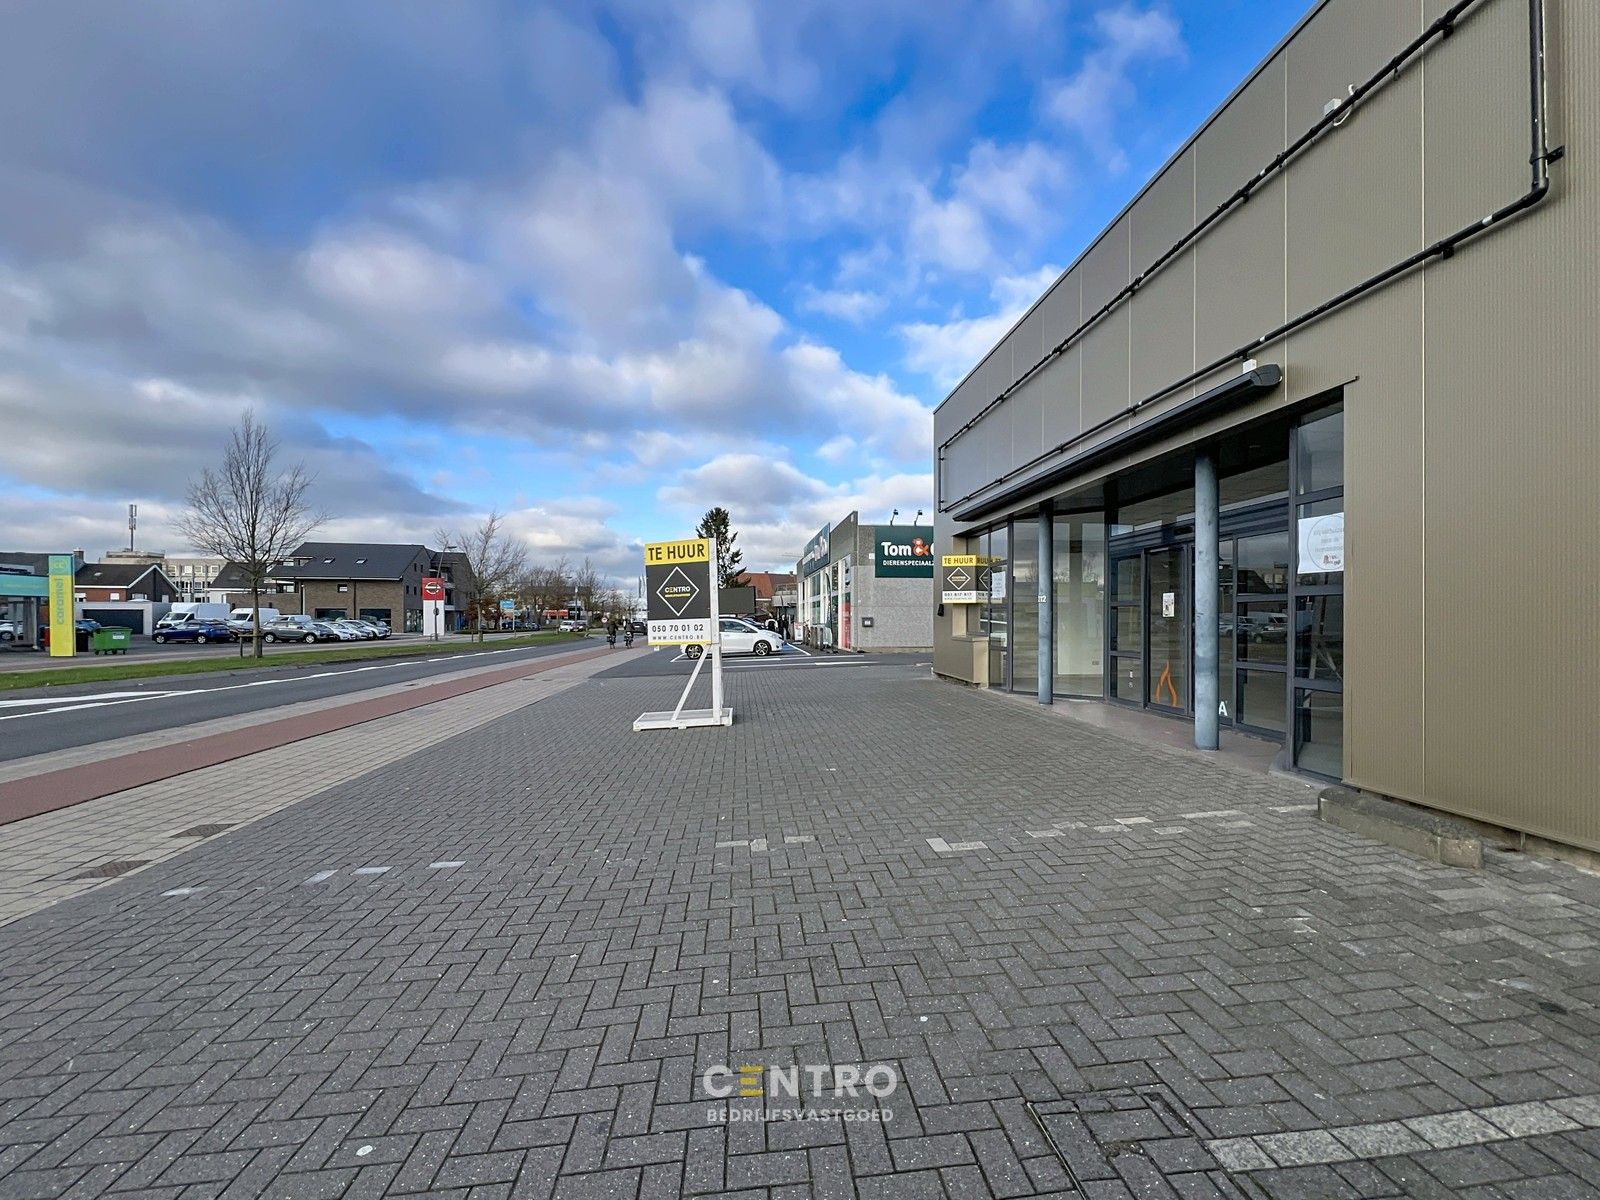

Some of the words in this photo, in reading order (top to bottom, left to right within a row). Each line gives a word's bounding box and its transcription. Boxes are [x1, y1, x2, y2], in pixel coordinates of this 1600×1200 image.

[648, 547, 662, 560] TE
[667, 544, 705, 560] HUUR
[652, 625, 667, 633] 050
